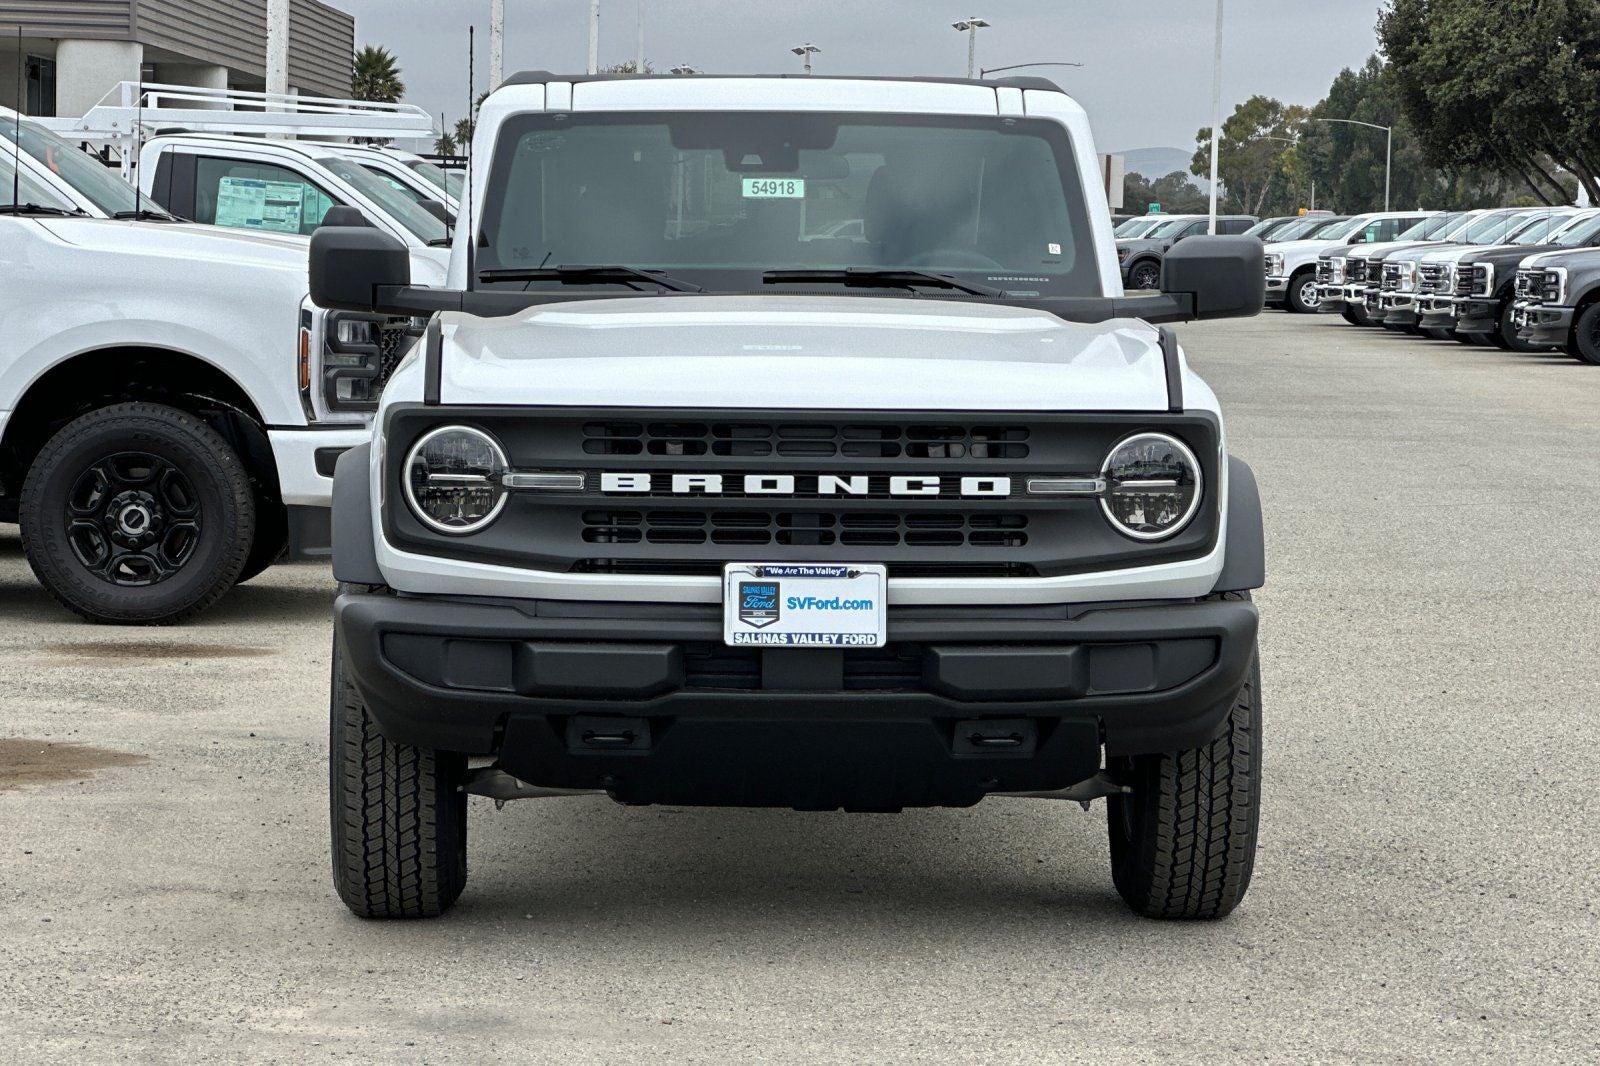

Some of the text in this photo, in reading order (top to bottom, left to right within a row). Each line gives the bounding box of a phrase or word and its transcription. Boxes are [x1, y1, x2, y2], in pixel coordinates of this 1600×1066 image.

[751, 181, 795, 195] 54918
[600, 472, 1011, 496] BRONCO
[784, 567, 798, 575] Are
[799, 567, 814, 575] The
[743, 595, 776, 608] Ford
[787, 596, 873, 610] SVFord.com
[734, 633, 877, 646] SALINAS VALLEY FORD
